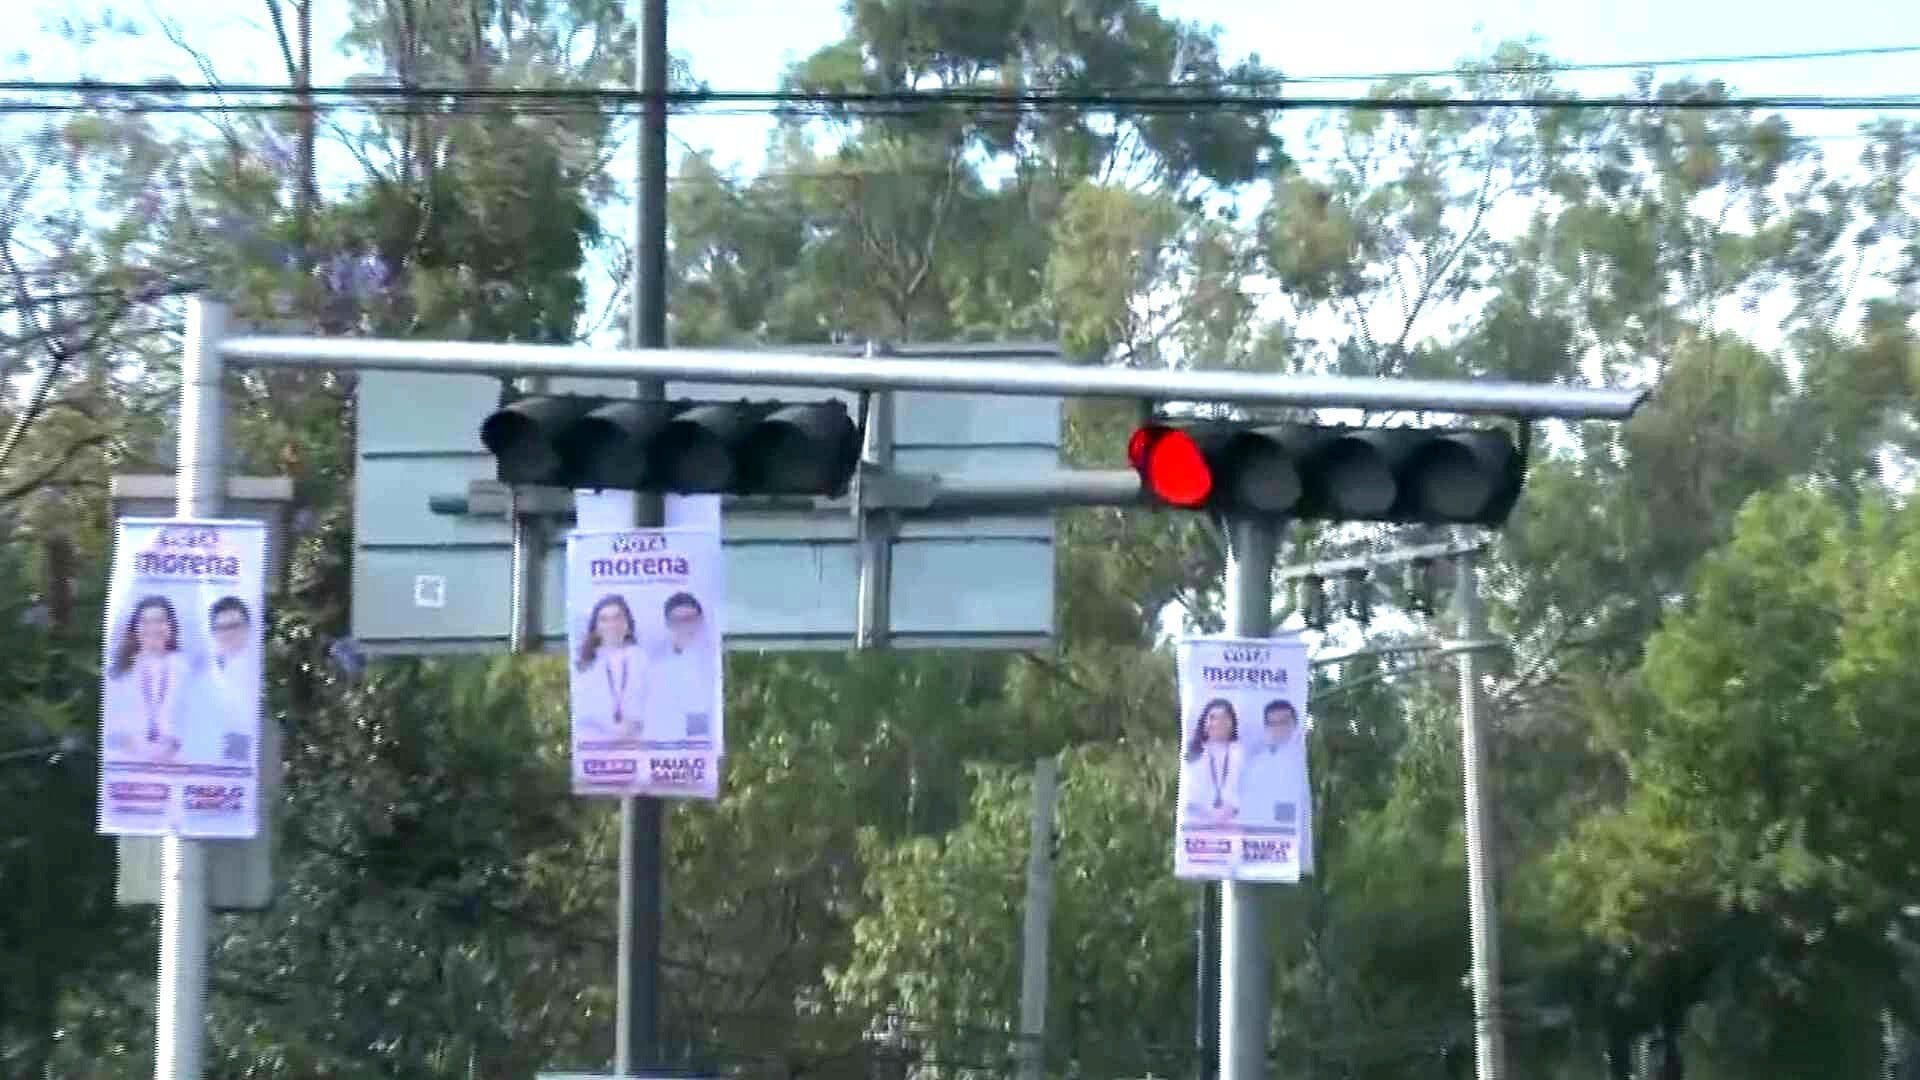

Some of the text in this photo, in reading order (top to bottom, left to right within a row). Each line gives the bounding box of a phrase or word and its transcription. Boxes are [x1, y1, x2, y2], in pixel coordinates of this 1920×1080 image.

[136, 552, 240, 576] morena
[591, 556, 689, 577] morena
[1202, 666, 1288, 684] morena
